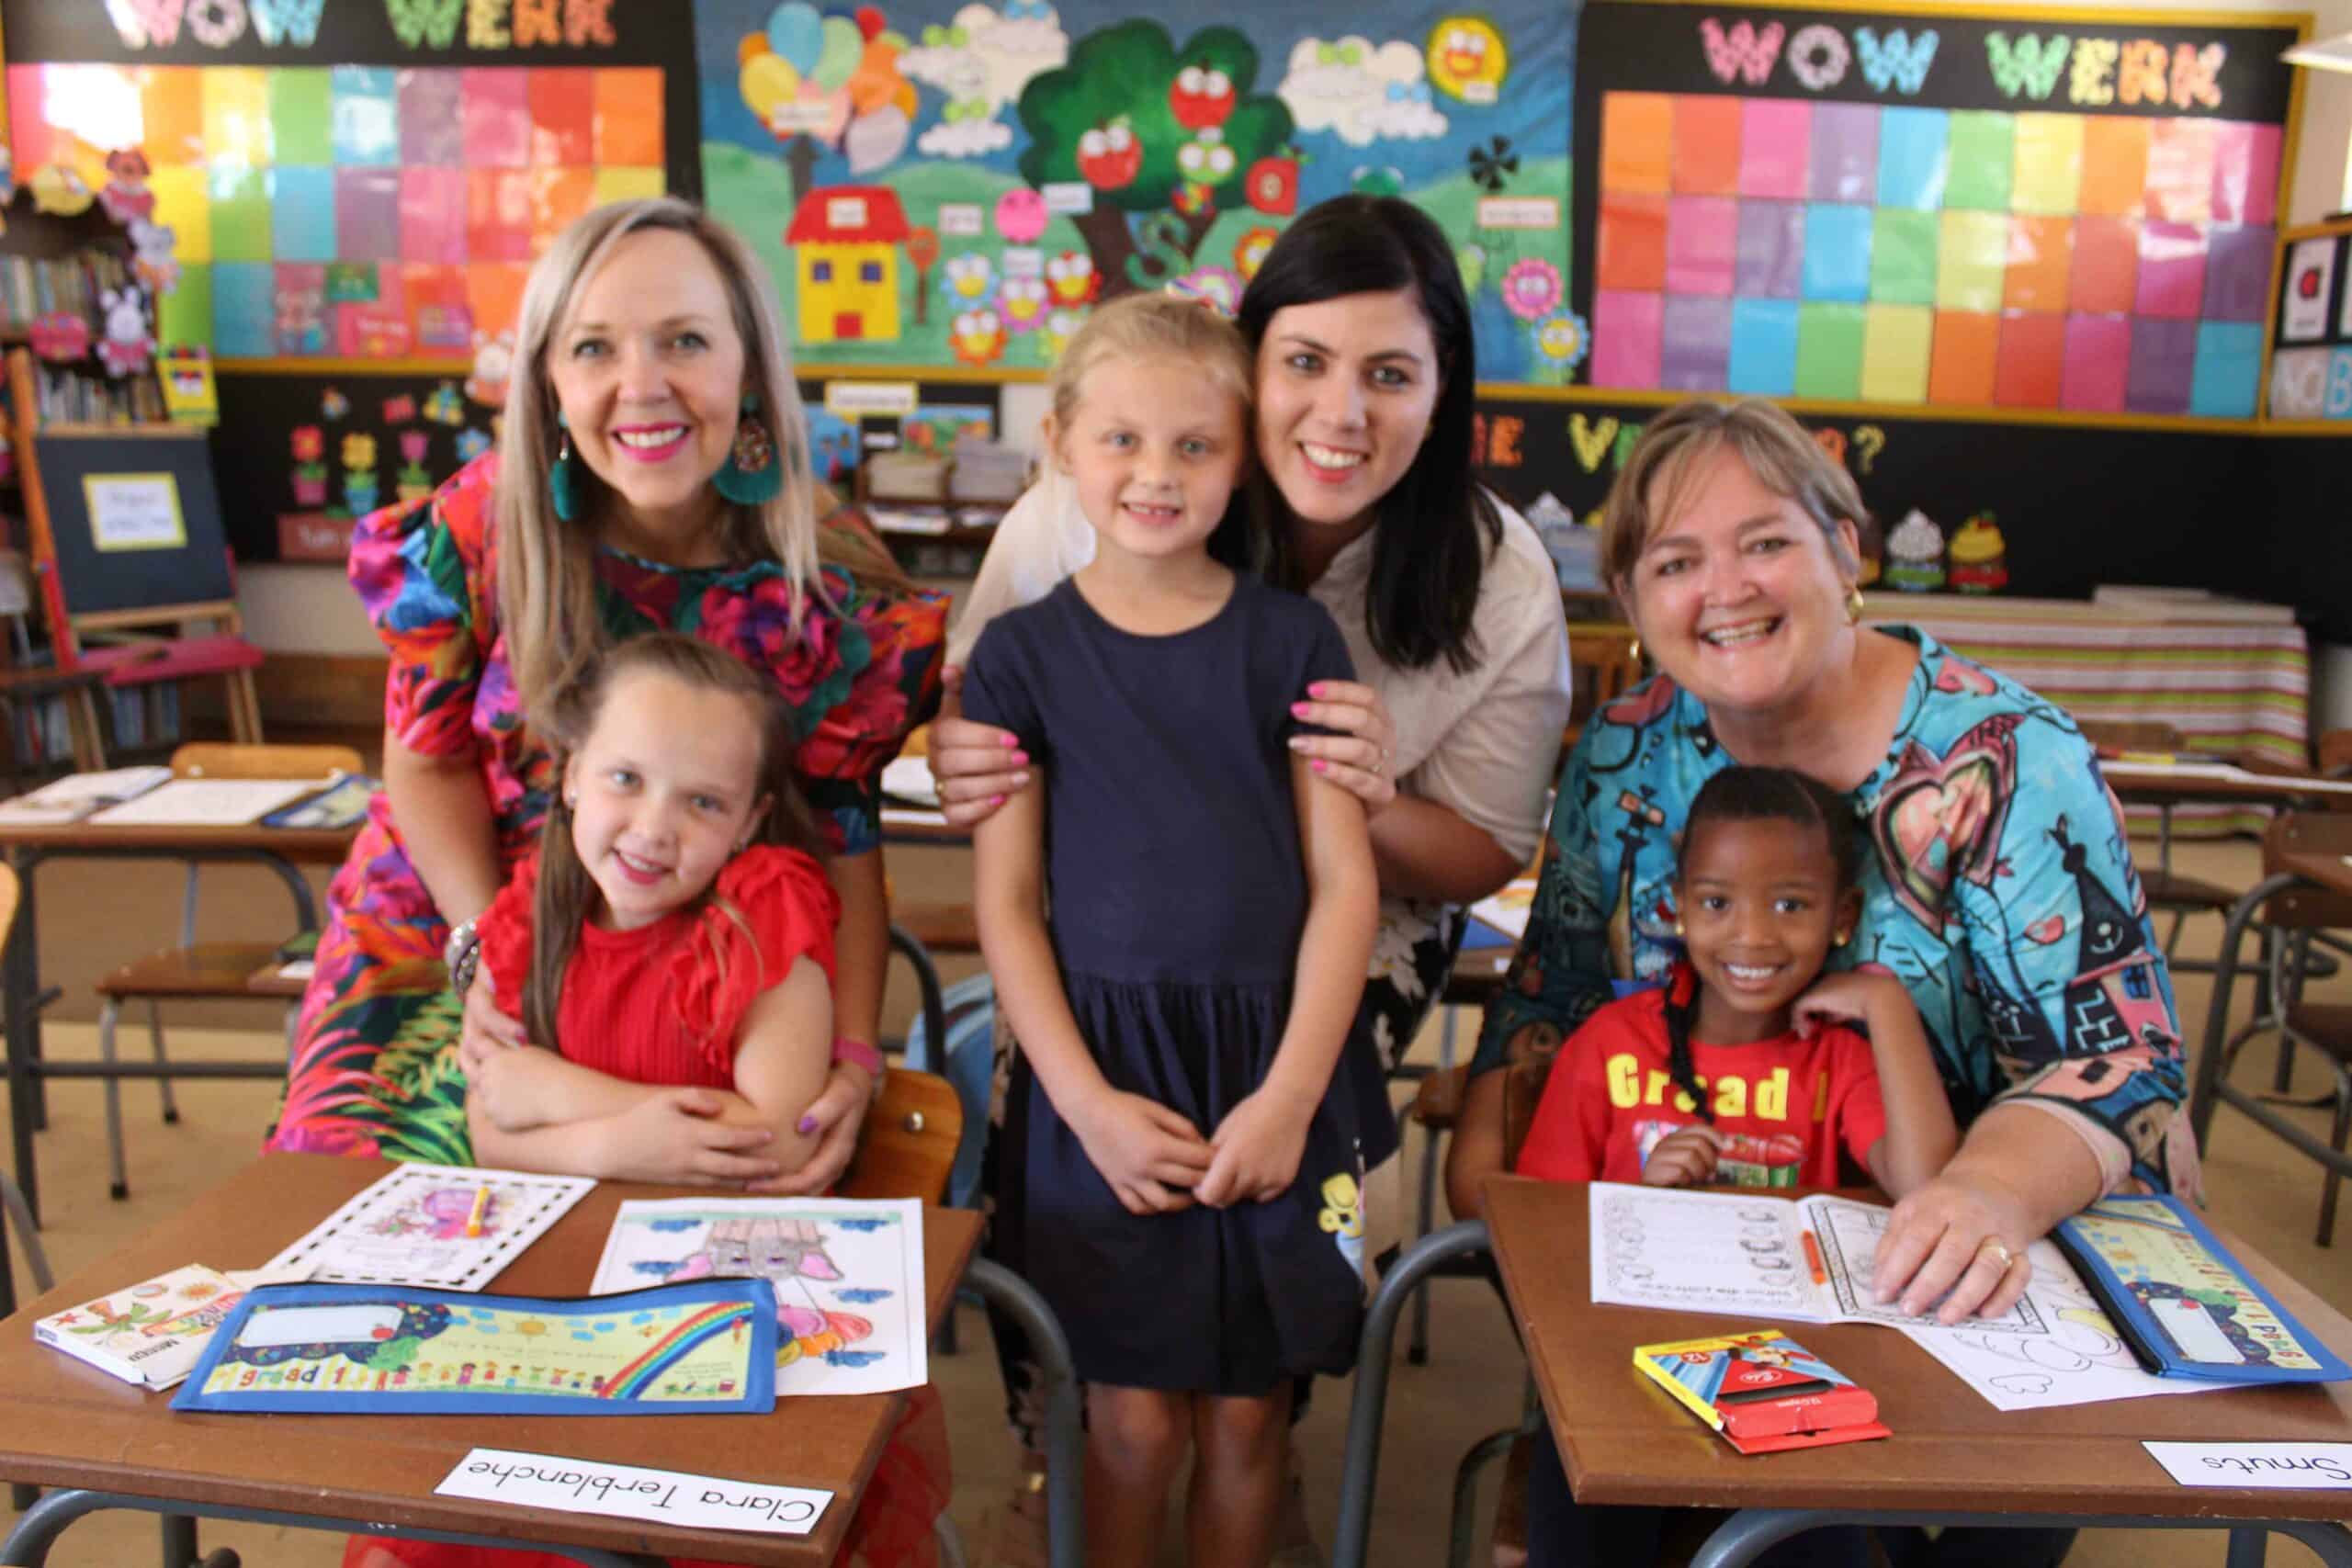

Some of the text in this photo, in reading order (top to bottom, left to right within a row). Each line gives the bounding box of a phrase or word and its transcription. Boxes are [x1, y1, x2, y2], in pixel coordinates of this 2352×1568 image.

[107, 0, 617, 51] WOW WERK
[1700, 17, 2227, 109] WOW WERK
[467, 1461, 817, 1522] Clara Terblanche
[2200, 1457, 2352, 1481] Smuts
